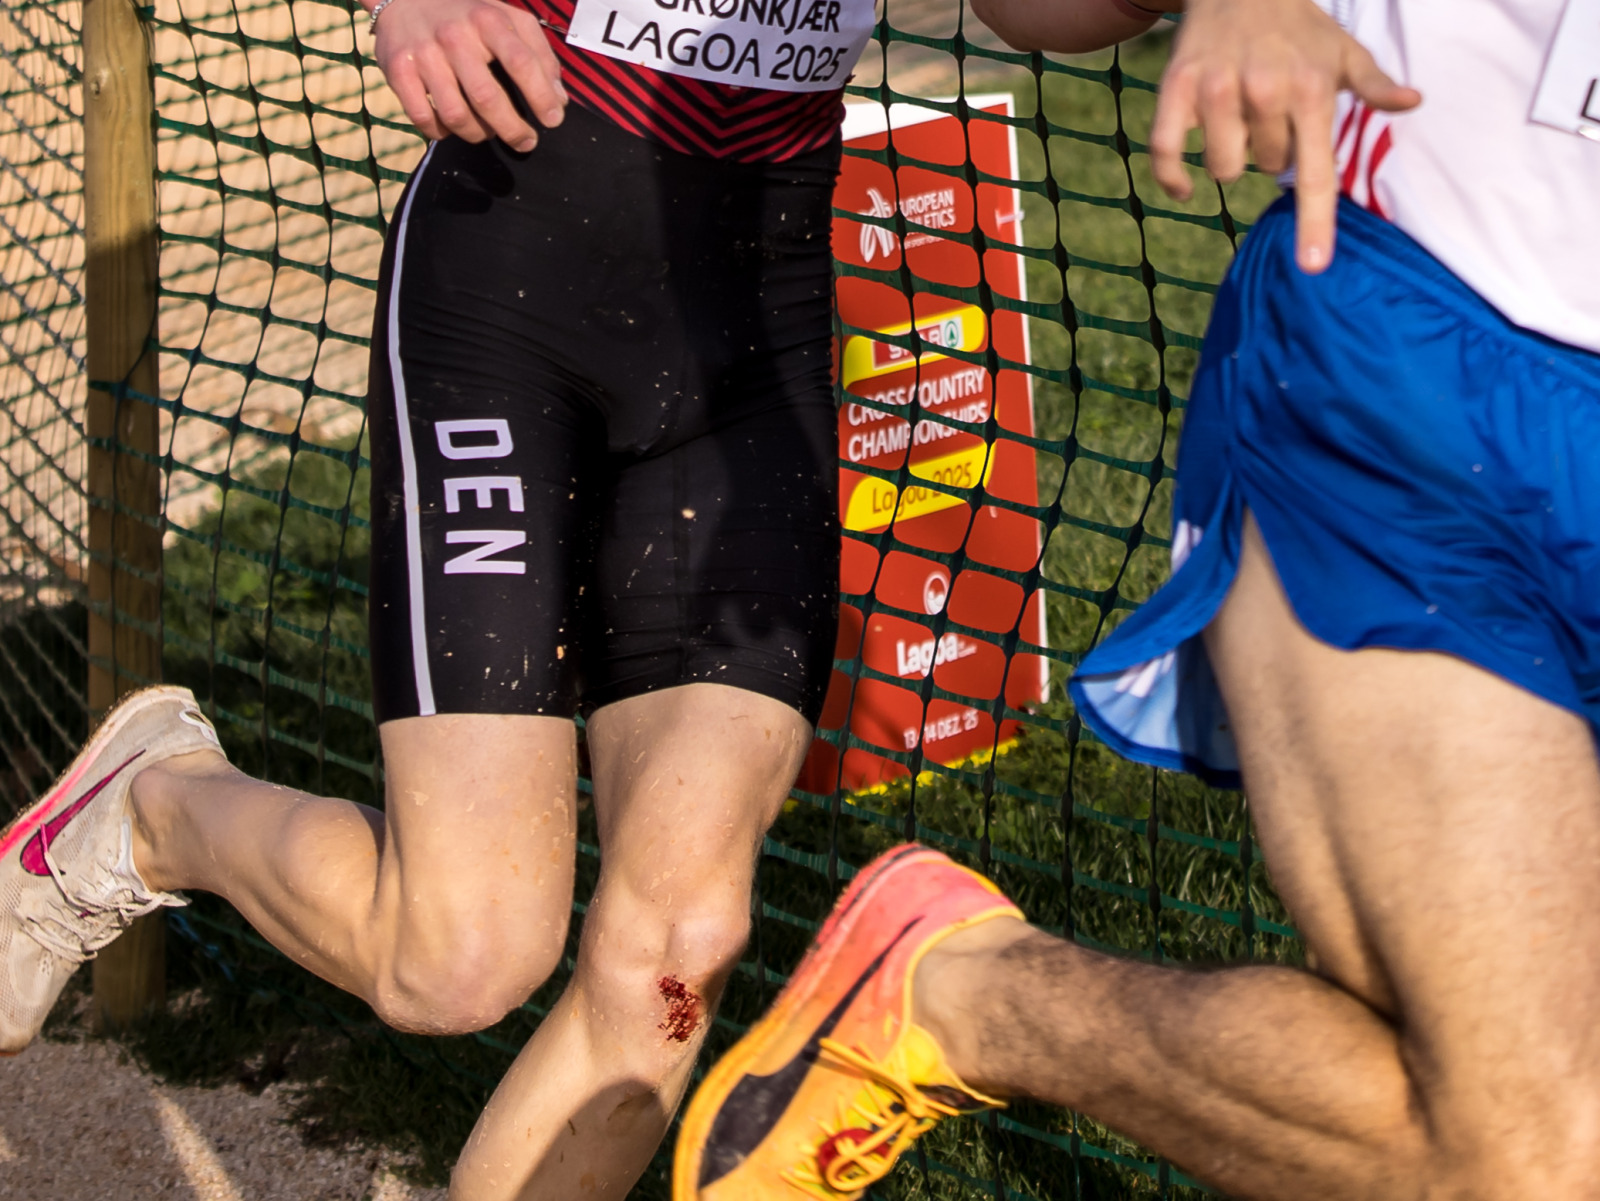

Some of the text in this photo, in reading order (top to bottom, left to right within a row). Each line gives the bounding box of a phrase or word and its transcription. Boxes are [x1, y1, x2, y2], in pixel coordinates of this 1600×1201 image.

[601, 11, 848, 82] LAGOA 2025
[434, 419, 526, 574] DEN
